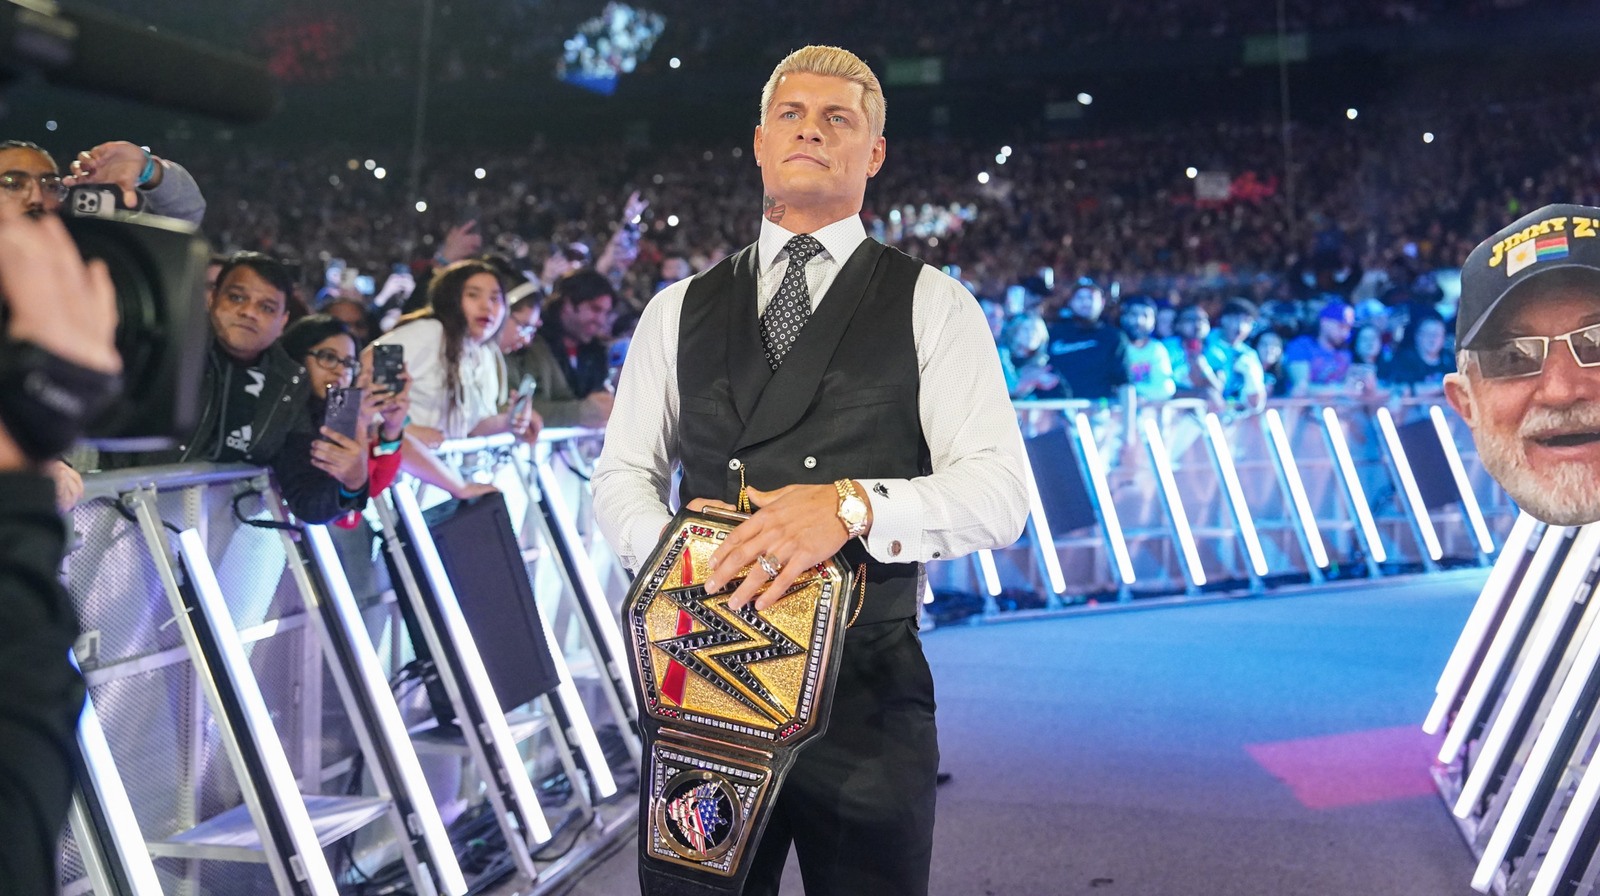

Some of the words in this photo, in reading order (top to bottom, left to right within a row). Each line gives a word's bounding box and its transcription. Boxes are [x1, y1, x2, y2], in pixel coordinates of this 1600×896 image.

[1488, 217, 1568, 268] JIMMY
[1572, 216, 1600, 239] Z'
[634, 615, 656, 693] CHAMPION
